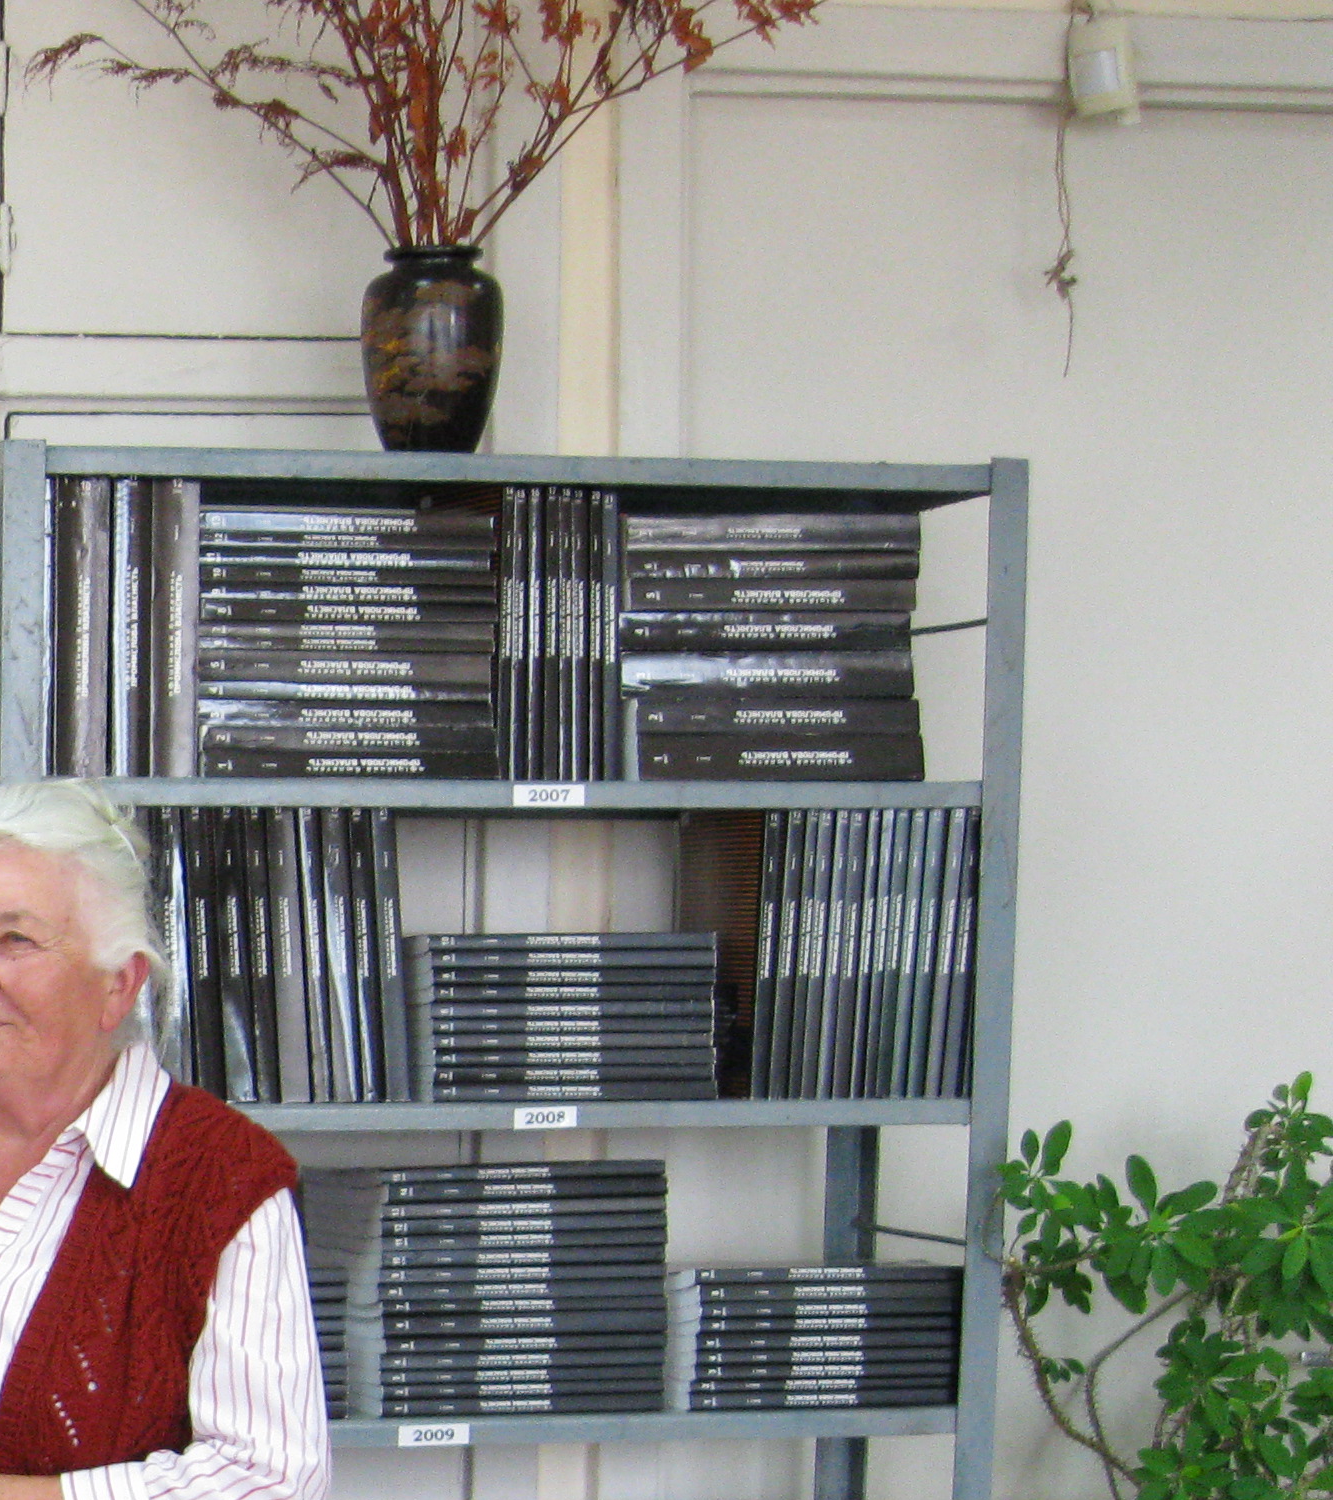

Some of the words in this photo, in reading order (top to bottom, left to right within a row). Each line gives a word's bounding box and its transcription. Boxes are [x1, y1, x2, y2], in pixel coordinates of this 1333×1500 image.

[528, 788, 572, 803] 2007
[524, 1111, 566, 1125] 2008
[413, 1428, 456, 1443] 2009
